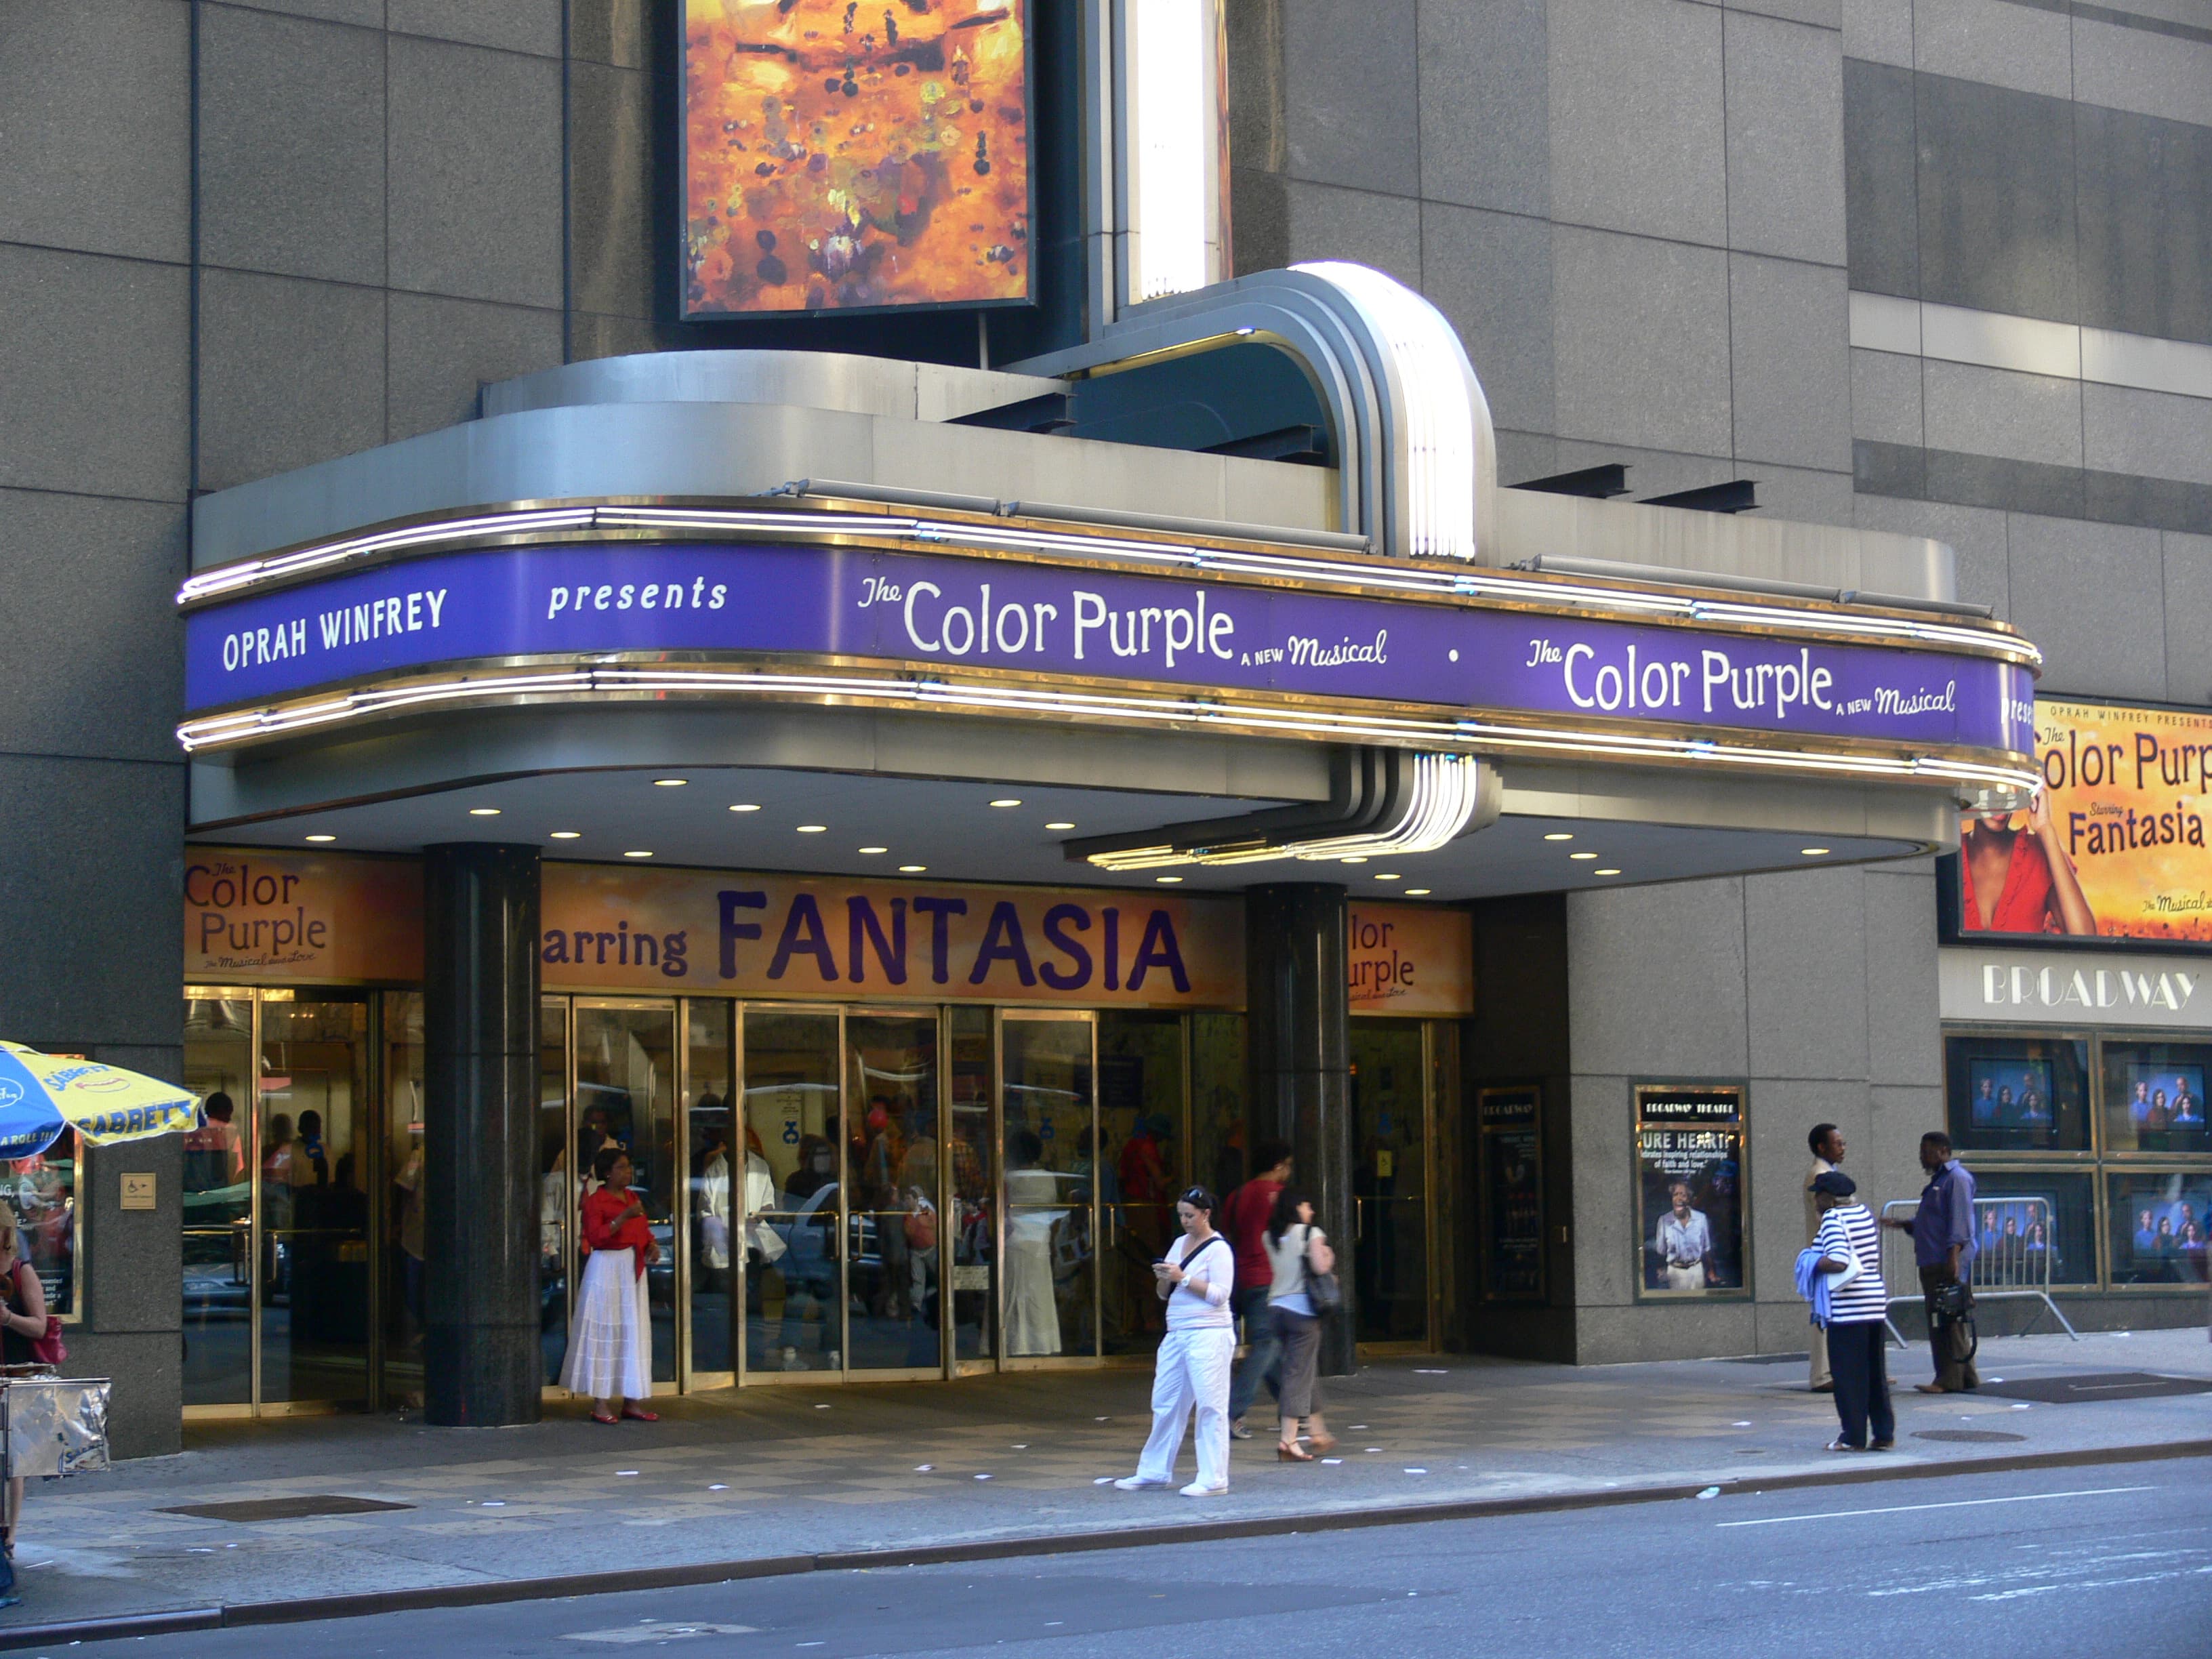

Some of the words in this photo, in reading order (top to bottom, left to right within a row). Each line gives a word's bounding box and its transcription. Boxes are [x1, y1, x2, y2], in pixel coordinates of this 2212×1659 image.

[548, 576, 727, 620] presents
[223, 618, 306, 672] OPRAH
[319, 588, 447, 650] WINFREY
[857, 576, 902, 607] The
[904, 581, 1058, 655] Color
[1073, 590, 1235, 668] Purple
[1241, 653, 1251, 666] A
[1254, 648, 1284, 665] NEW
[1288, 629, 1387, 666] Musical
[1526, 639, 1562, 667] The
[1564, 643, 1691, 711] Color
[1702, 648, 1832, 718] Purple
[1836, 703, 1845, 716] A
[1847, 699, 1872, 715] NEW
[1875, 680, 1955, 715] Musical
[2050, 705, 2089, 718] OPRAH
[2098, 710, 2149, 723] WINFREY
[2043, 726, 2065, 745] The
[2034, 729, 2123, 790] olor
[2069, 800, 2205, 856] Fantasia
[2089, 802, 2125, 818] Starring
[184, 864, 300, 908] Color
[212, 863, 236, 876] The
[2157, 890, 2205, 912] Musical
[201, 906, 327, 956] Purple
[717, 890, 1191, 993] FANTASIA
[218, 953, 267, 968] Musical
[1982, 964, 2200, 1010] BROADWAY
[76, 1099, 191, 1137] SABRETT
[1646, 1103, 1693, 1113] BROADWAY
[1696, 1103, 1734, 1113] THEATRE
[11, 1132, 37, 1145] ROLL
[1640, 1132, 1671, 1149] URE
[1678, 1160, 1690, 1168] and
